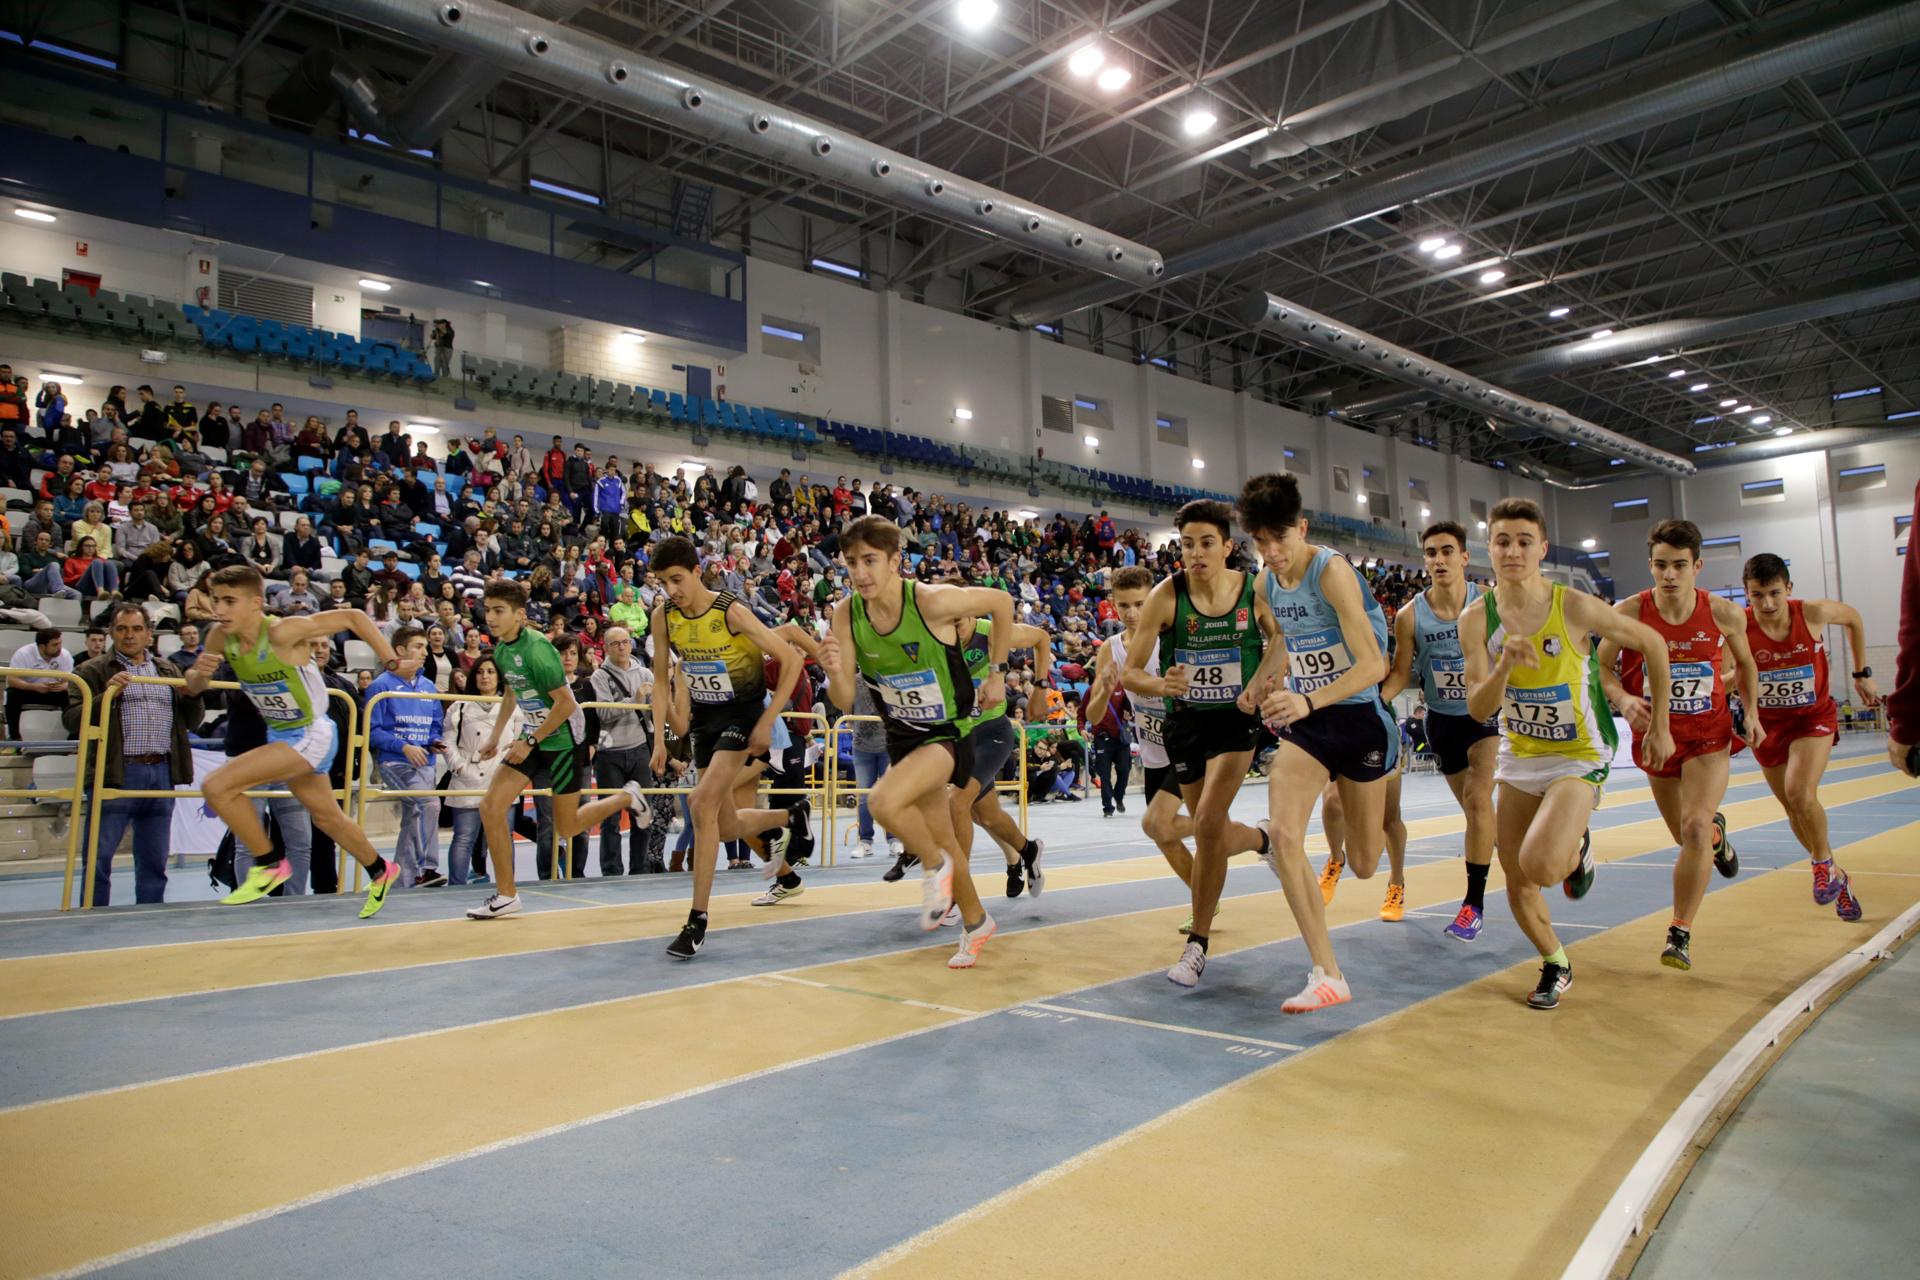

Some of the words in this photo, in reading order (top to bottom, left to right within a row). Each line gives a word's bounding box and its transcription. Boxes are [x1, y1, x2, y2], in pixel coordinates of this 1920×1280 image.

[1273, 602, 1308, 621] nerja
[1188, 633, 1231, 643] VILLARREAL
[1424, 625, 1459, 642] nerj
[1296, 651, 1335, 676] 199
[688, 674, 721, 691] 216
[1193, 667, 1223, 686] 48
[1299, 674, 1343, 693] Jom
[1184, 687, 1234, 700] Joma
[1443, 688, 1467, 699] Jo
[1672, 679, 1701, 698] 67
[1762, 681, 1804, 697] 268
[253, 695, 288, 709] 148
[895, 690, 922, 706] 18
[1669, 699, 1704, 711] ma
[1759, 694, 1809, 707] Joma
[888, 706, 938, 719] Joma
[1511, 702, 1559, 725] 173
[1510, 719, 1568, 739] Joma
[1225, 1045, 1277, 1059] 100
